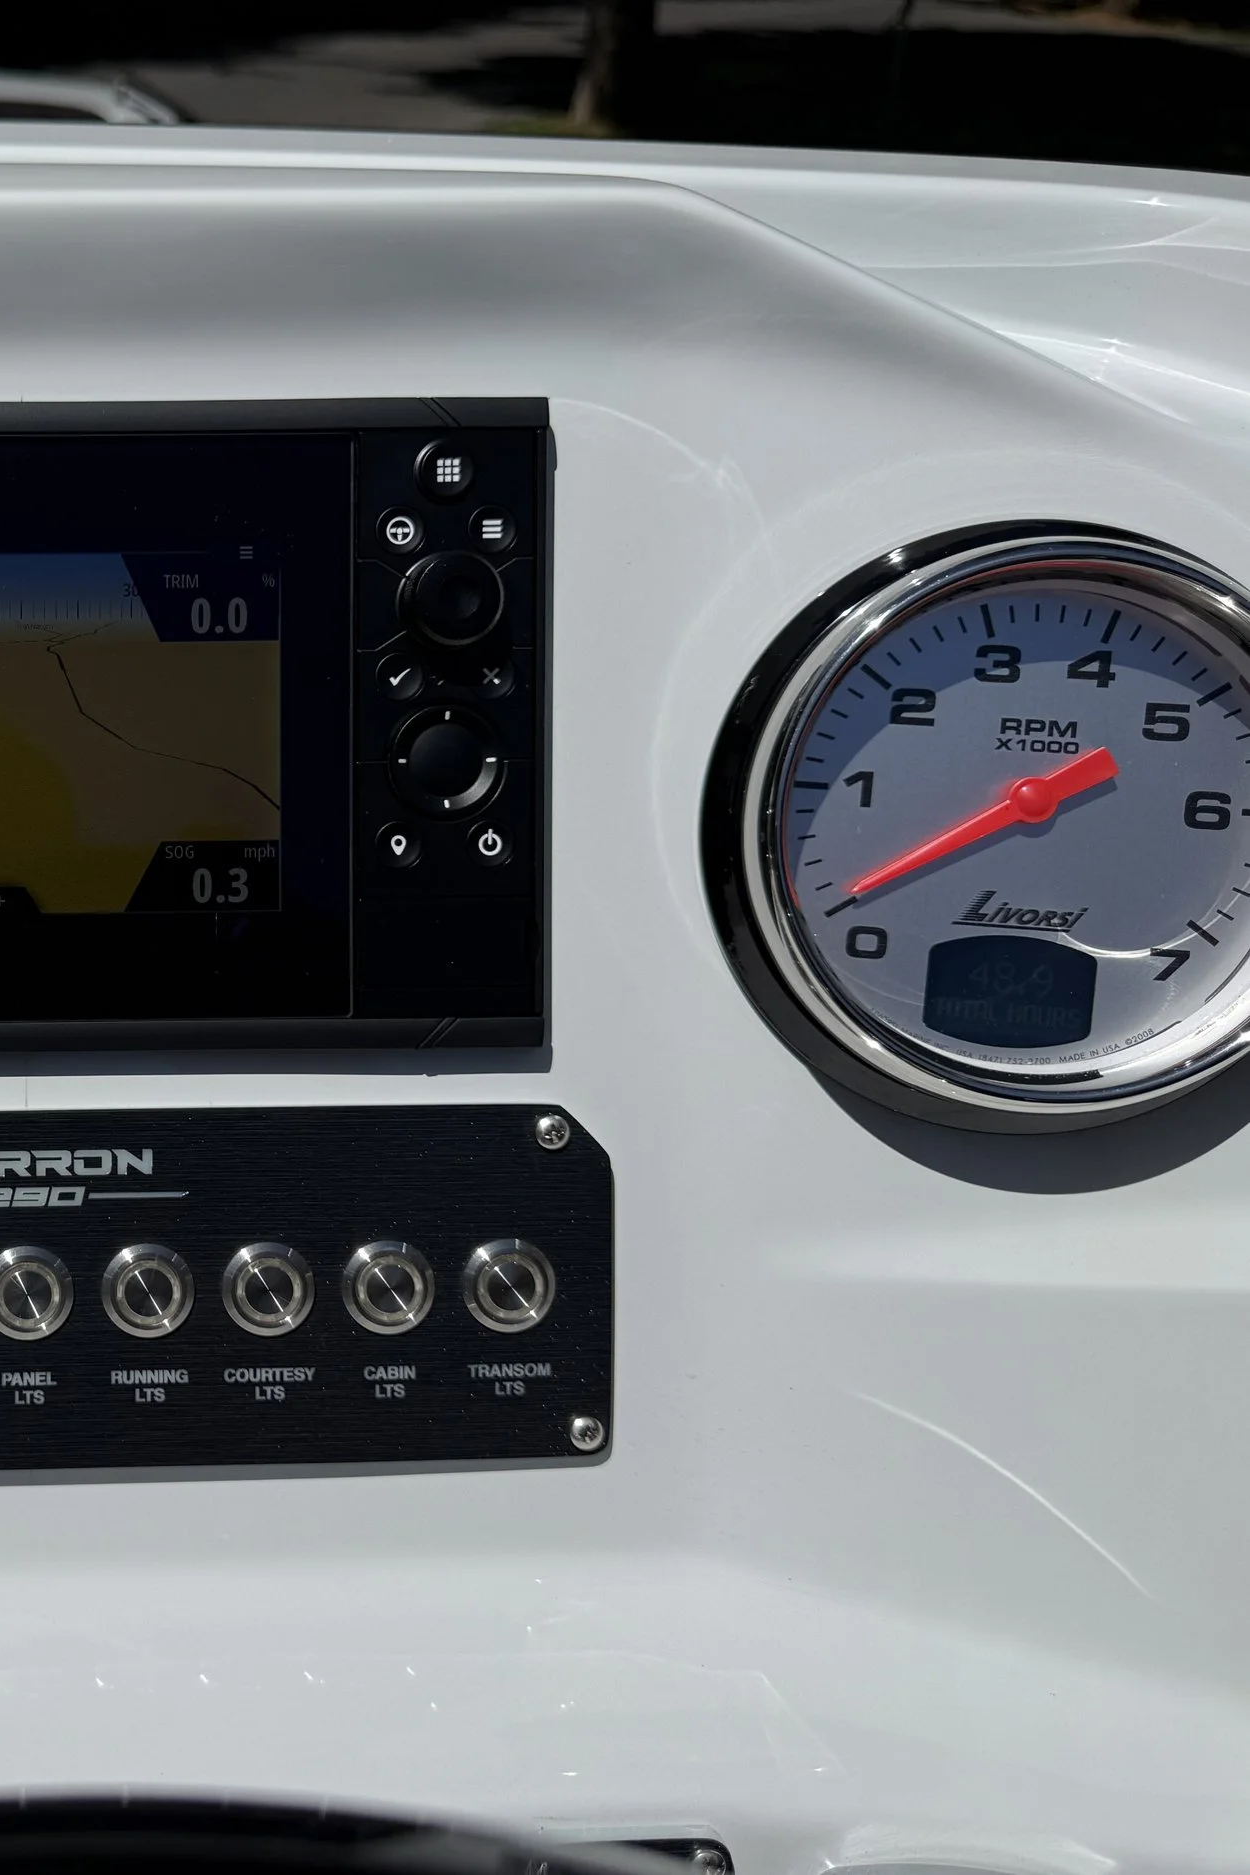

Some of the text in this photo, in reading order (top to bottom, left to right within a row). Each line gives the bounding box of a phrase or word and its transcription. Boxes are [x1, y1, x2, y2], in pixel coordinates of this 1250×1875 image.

[163, 574, 199, 589] TRIM
[261, 573, 276, 588] %
[190, 597, 248, 635] 0.0
[973, 645, 1022, 683] 3
[1067, 650, 1116, 688] 4
[889, 687, 937, 727] 2
[1000, 717, 1078, 739] RPM
[1142, 702, 1191, 742] 5
[994, 738, 1080, 755] X1000
[843, 770, 875, 808] 1
[1184, 791, 1232, 831] 6
[164, 844, 195, 859] SOG
[243, 841, 276, 863] mph
[192, 867, 249, 904] 0.3
[845, 925, 888, 960] 0
[1150, 947, 1191, 982] 7
[1059, 1052, 1086, 1063] MADE
[1089, 1048, 1101, 1058] IN
[1103, 1043, 1121, 1054] USA
[110, 1369, 189, 1385] RUNNING
[223, 1367, 316, 1383] COURTESY
[363, 1365, 416, 1381] CABIN
[467, 1362, 552, 1378] TRANSOM
[1, 1371, 57, 1387] PANEL
[134, 1387, 166, 1403] LTS
[255, 1385, 286, 1401] LTS
[375, 1383, 406, 1398] LTS
[494, 1380, 526, 1396] LTS
[14, 1389, 45, 1405] LTS
